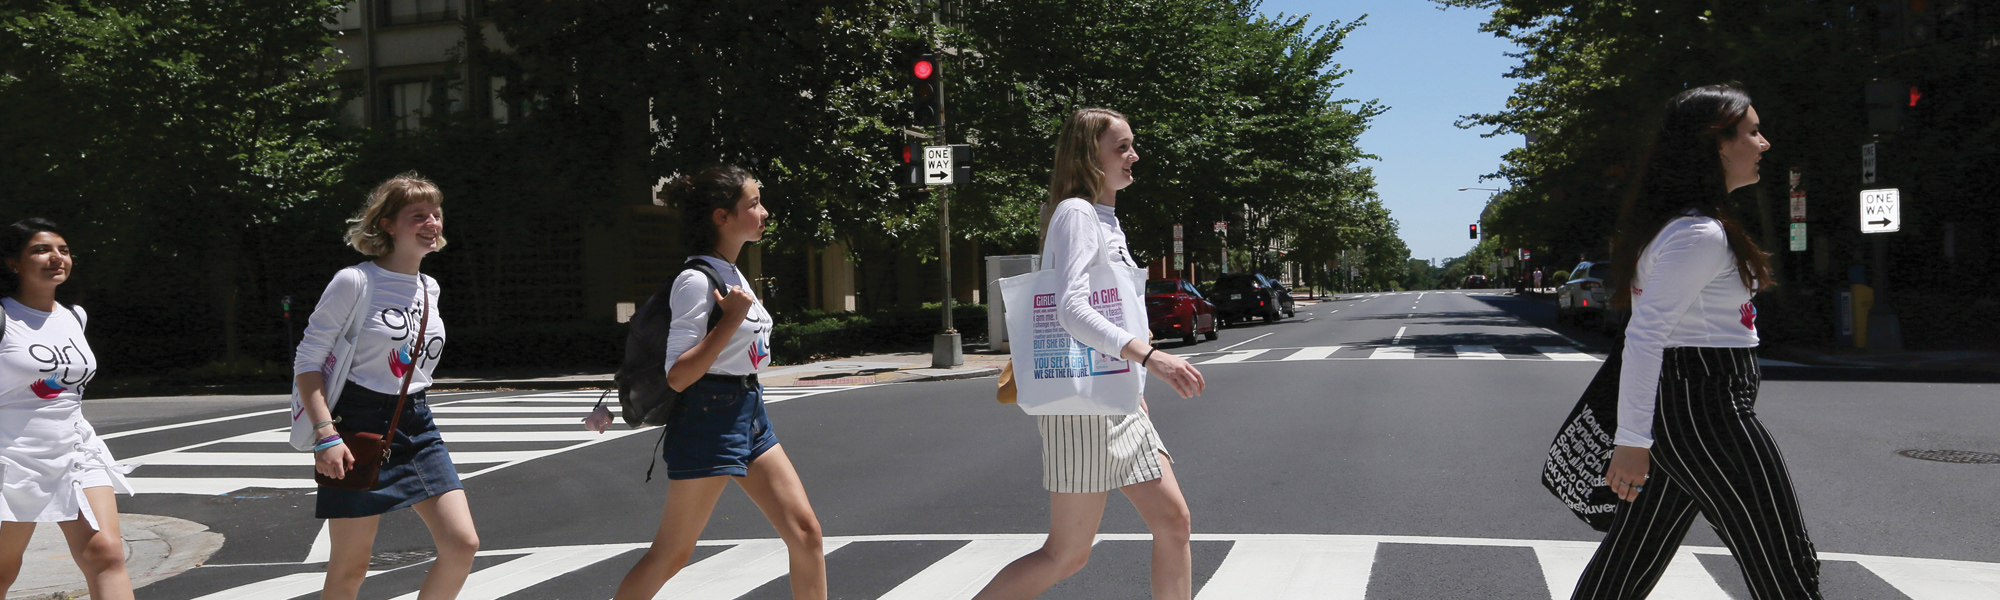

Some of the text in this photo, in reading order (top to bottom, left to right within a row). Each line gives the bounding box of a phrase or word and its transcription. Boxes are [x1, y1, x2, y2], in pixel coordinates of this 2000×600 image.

[928, 150, 948, 159] ONE
[928, 160, 949, 169] WAY
[1866, 193, 1893, 204] ONE
[1866, 205, 1894, 215] WAY
[1101, 287, 1123, 304] GIRL.
[1033, 339, 1046, 349] BUT
[1046, 338, 1058, 348] SHE
[1058, 338, 1066, 348] IS
[28, 338, 88, 372] girl
[1033, 356, 1089, 369] YOU SEE A GIRL.
[1034, 367, 1090, 379] WE SEE THE FUTURE.
[1575, 479, 1594, 503] Cit
